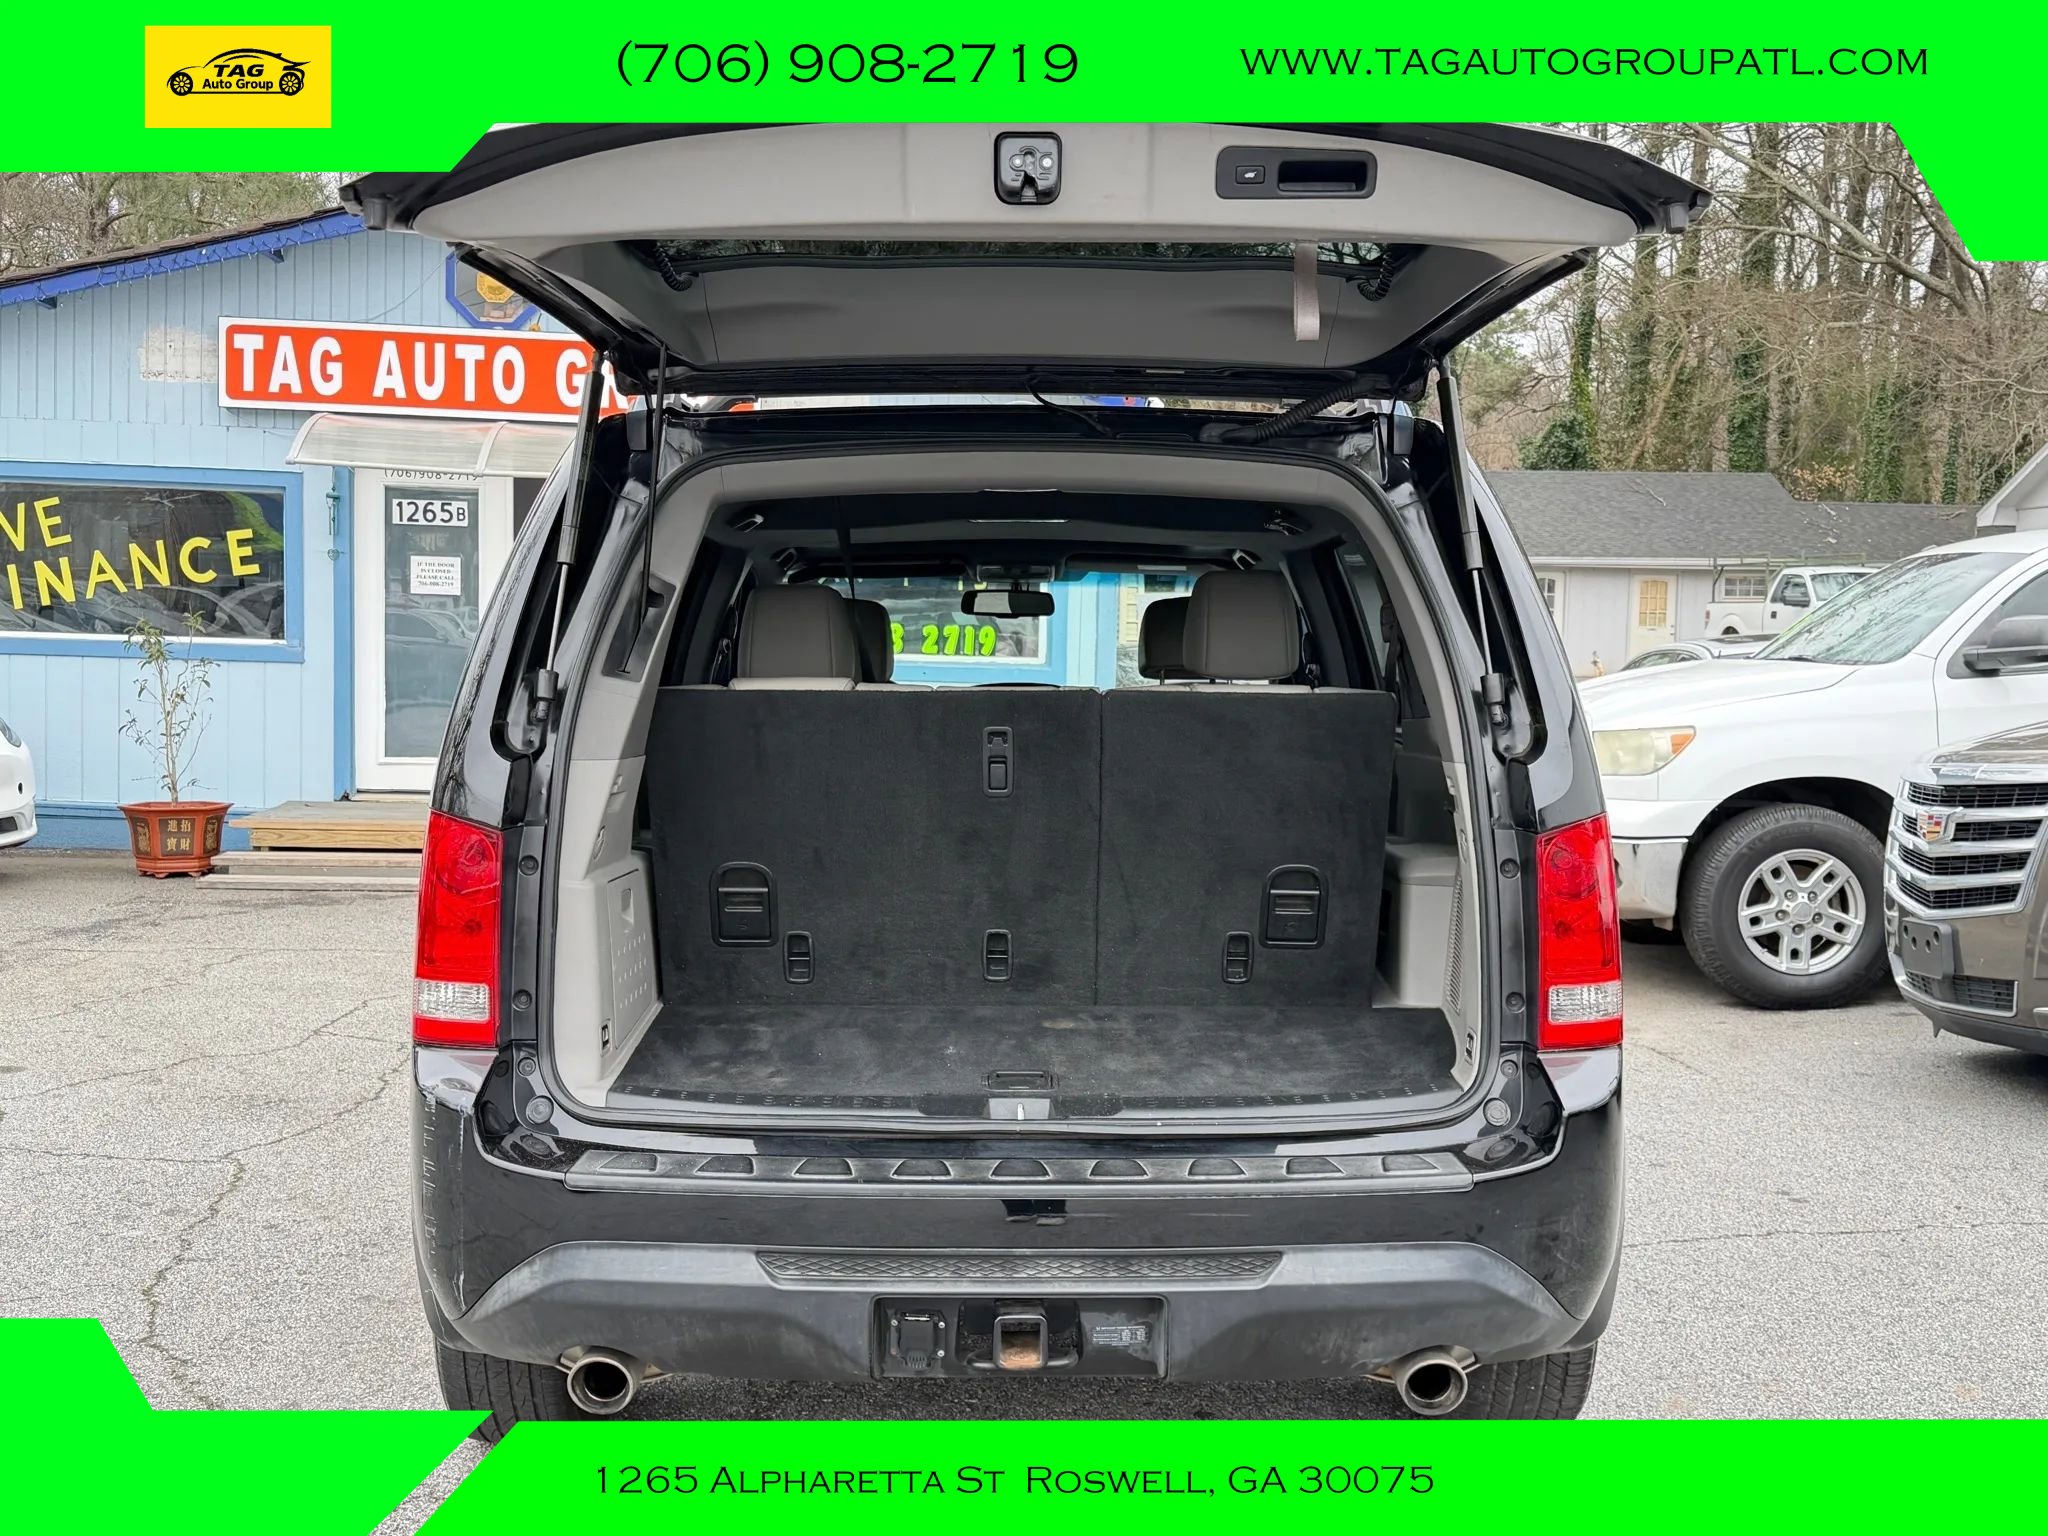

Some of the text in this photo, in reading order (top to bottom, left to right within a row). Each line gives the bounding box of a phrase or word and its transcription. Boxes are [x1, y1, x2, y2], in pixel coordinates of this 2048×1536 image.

[233, 333, 343, 397] TAG
[372, 340, 526, 405] AUTO
[921, 624, 996, 656] 2719
